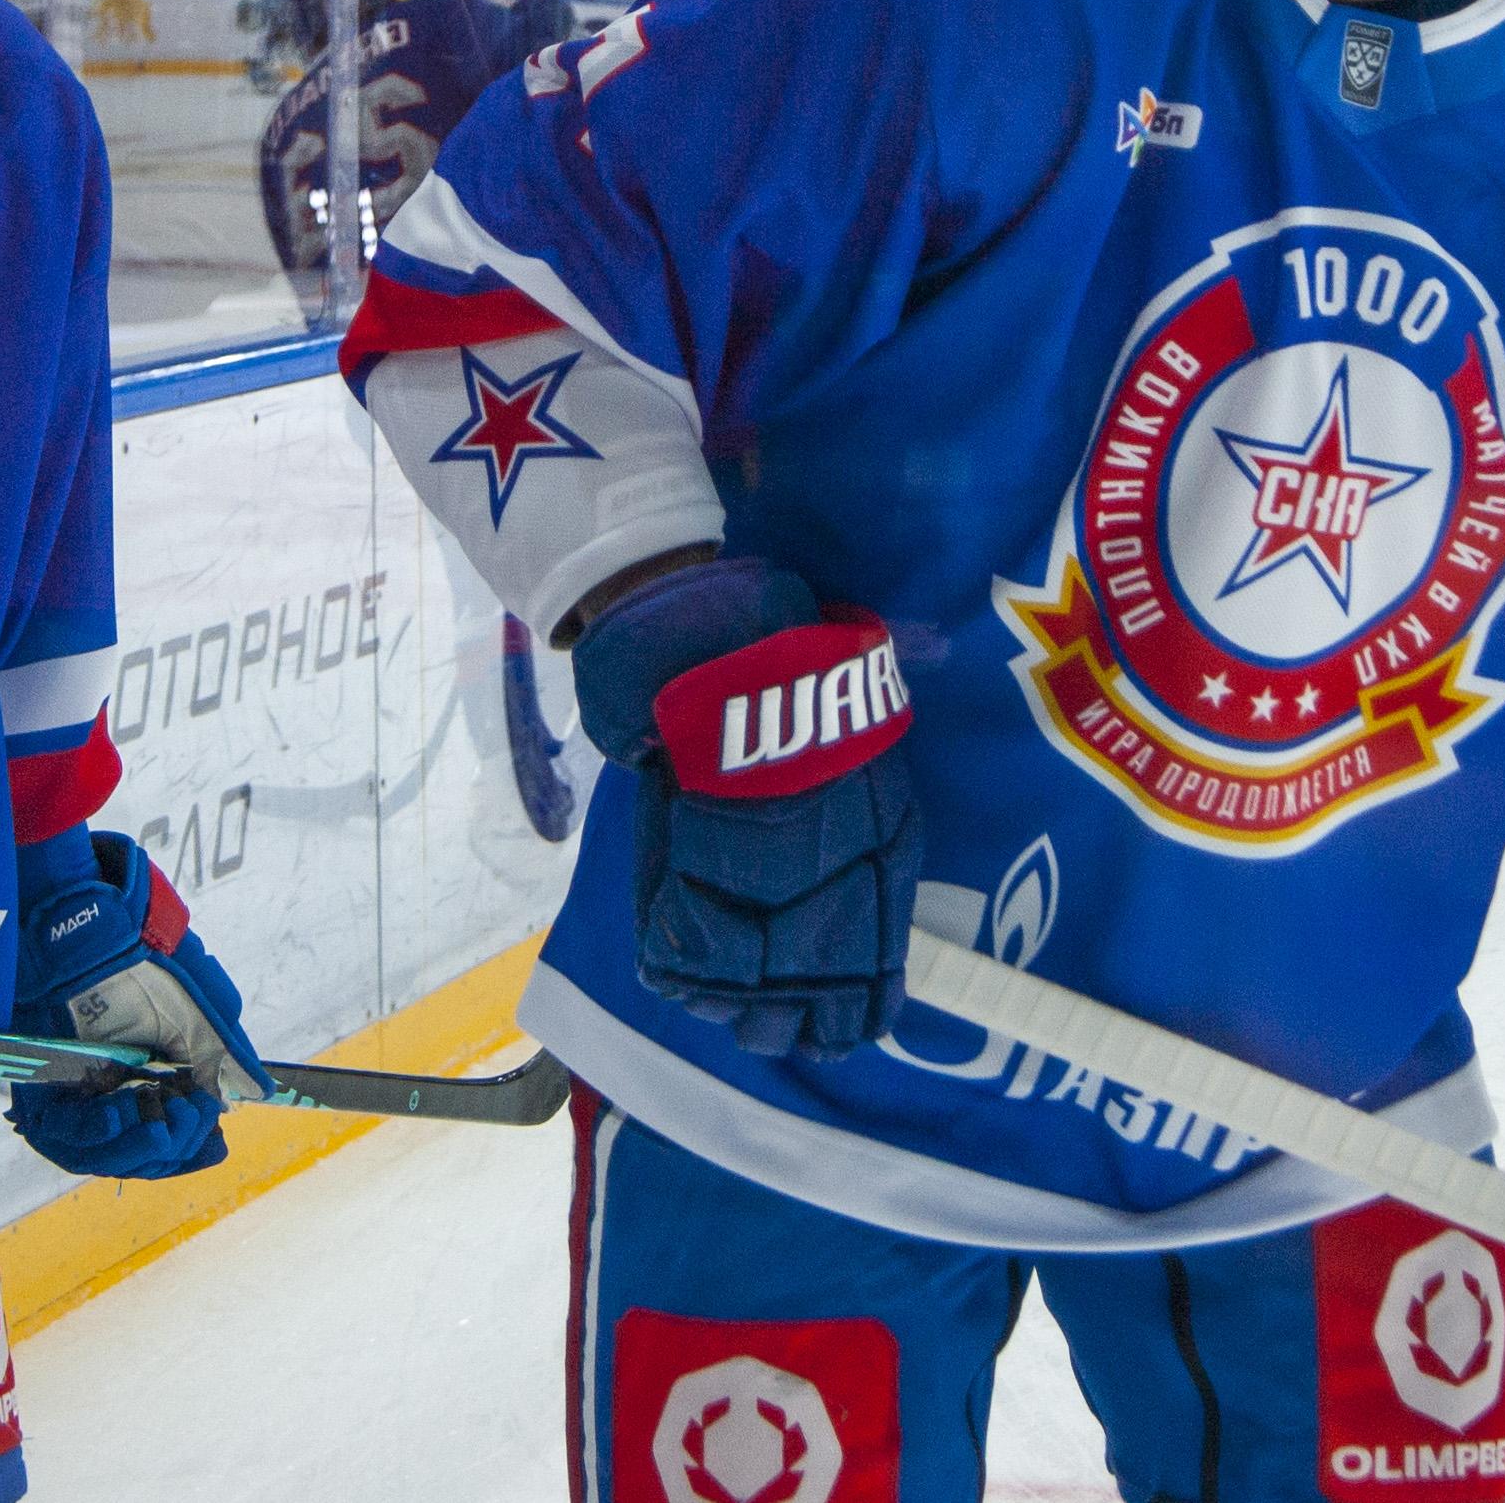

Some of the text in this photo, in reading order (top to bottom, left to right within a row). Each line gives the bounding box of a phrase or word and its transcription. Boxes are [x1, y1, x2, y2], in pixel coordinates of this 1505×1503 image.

[1282, 246, 1449, 346] 1000
[1097, 339, 1201, 636] ПЛОТНИКОВ
[1256, 466, 1371, 539] СКА
[1423, 585, 1460, 613] В
[112, 571, 388, 746] ОТОРНОЕ
[1353, 611, 1433, 685] КХЛ
[1076, 698, 1372, 822] ИГРА ПРОДОЛЖАЕТСЯ
[50, 902, 99, 942] MACH
